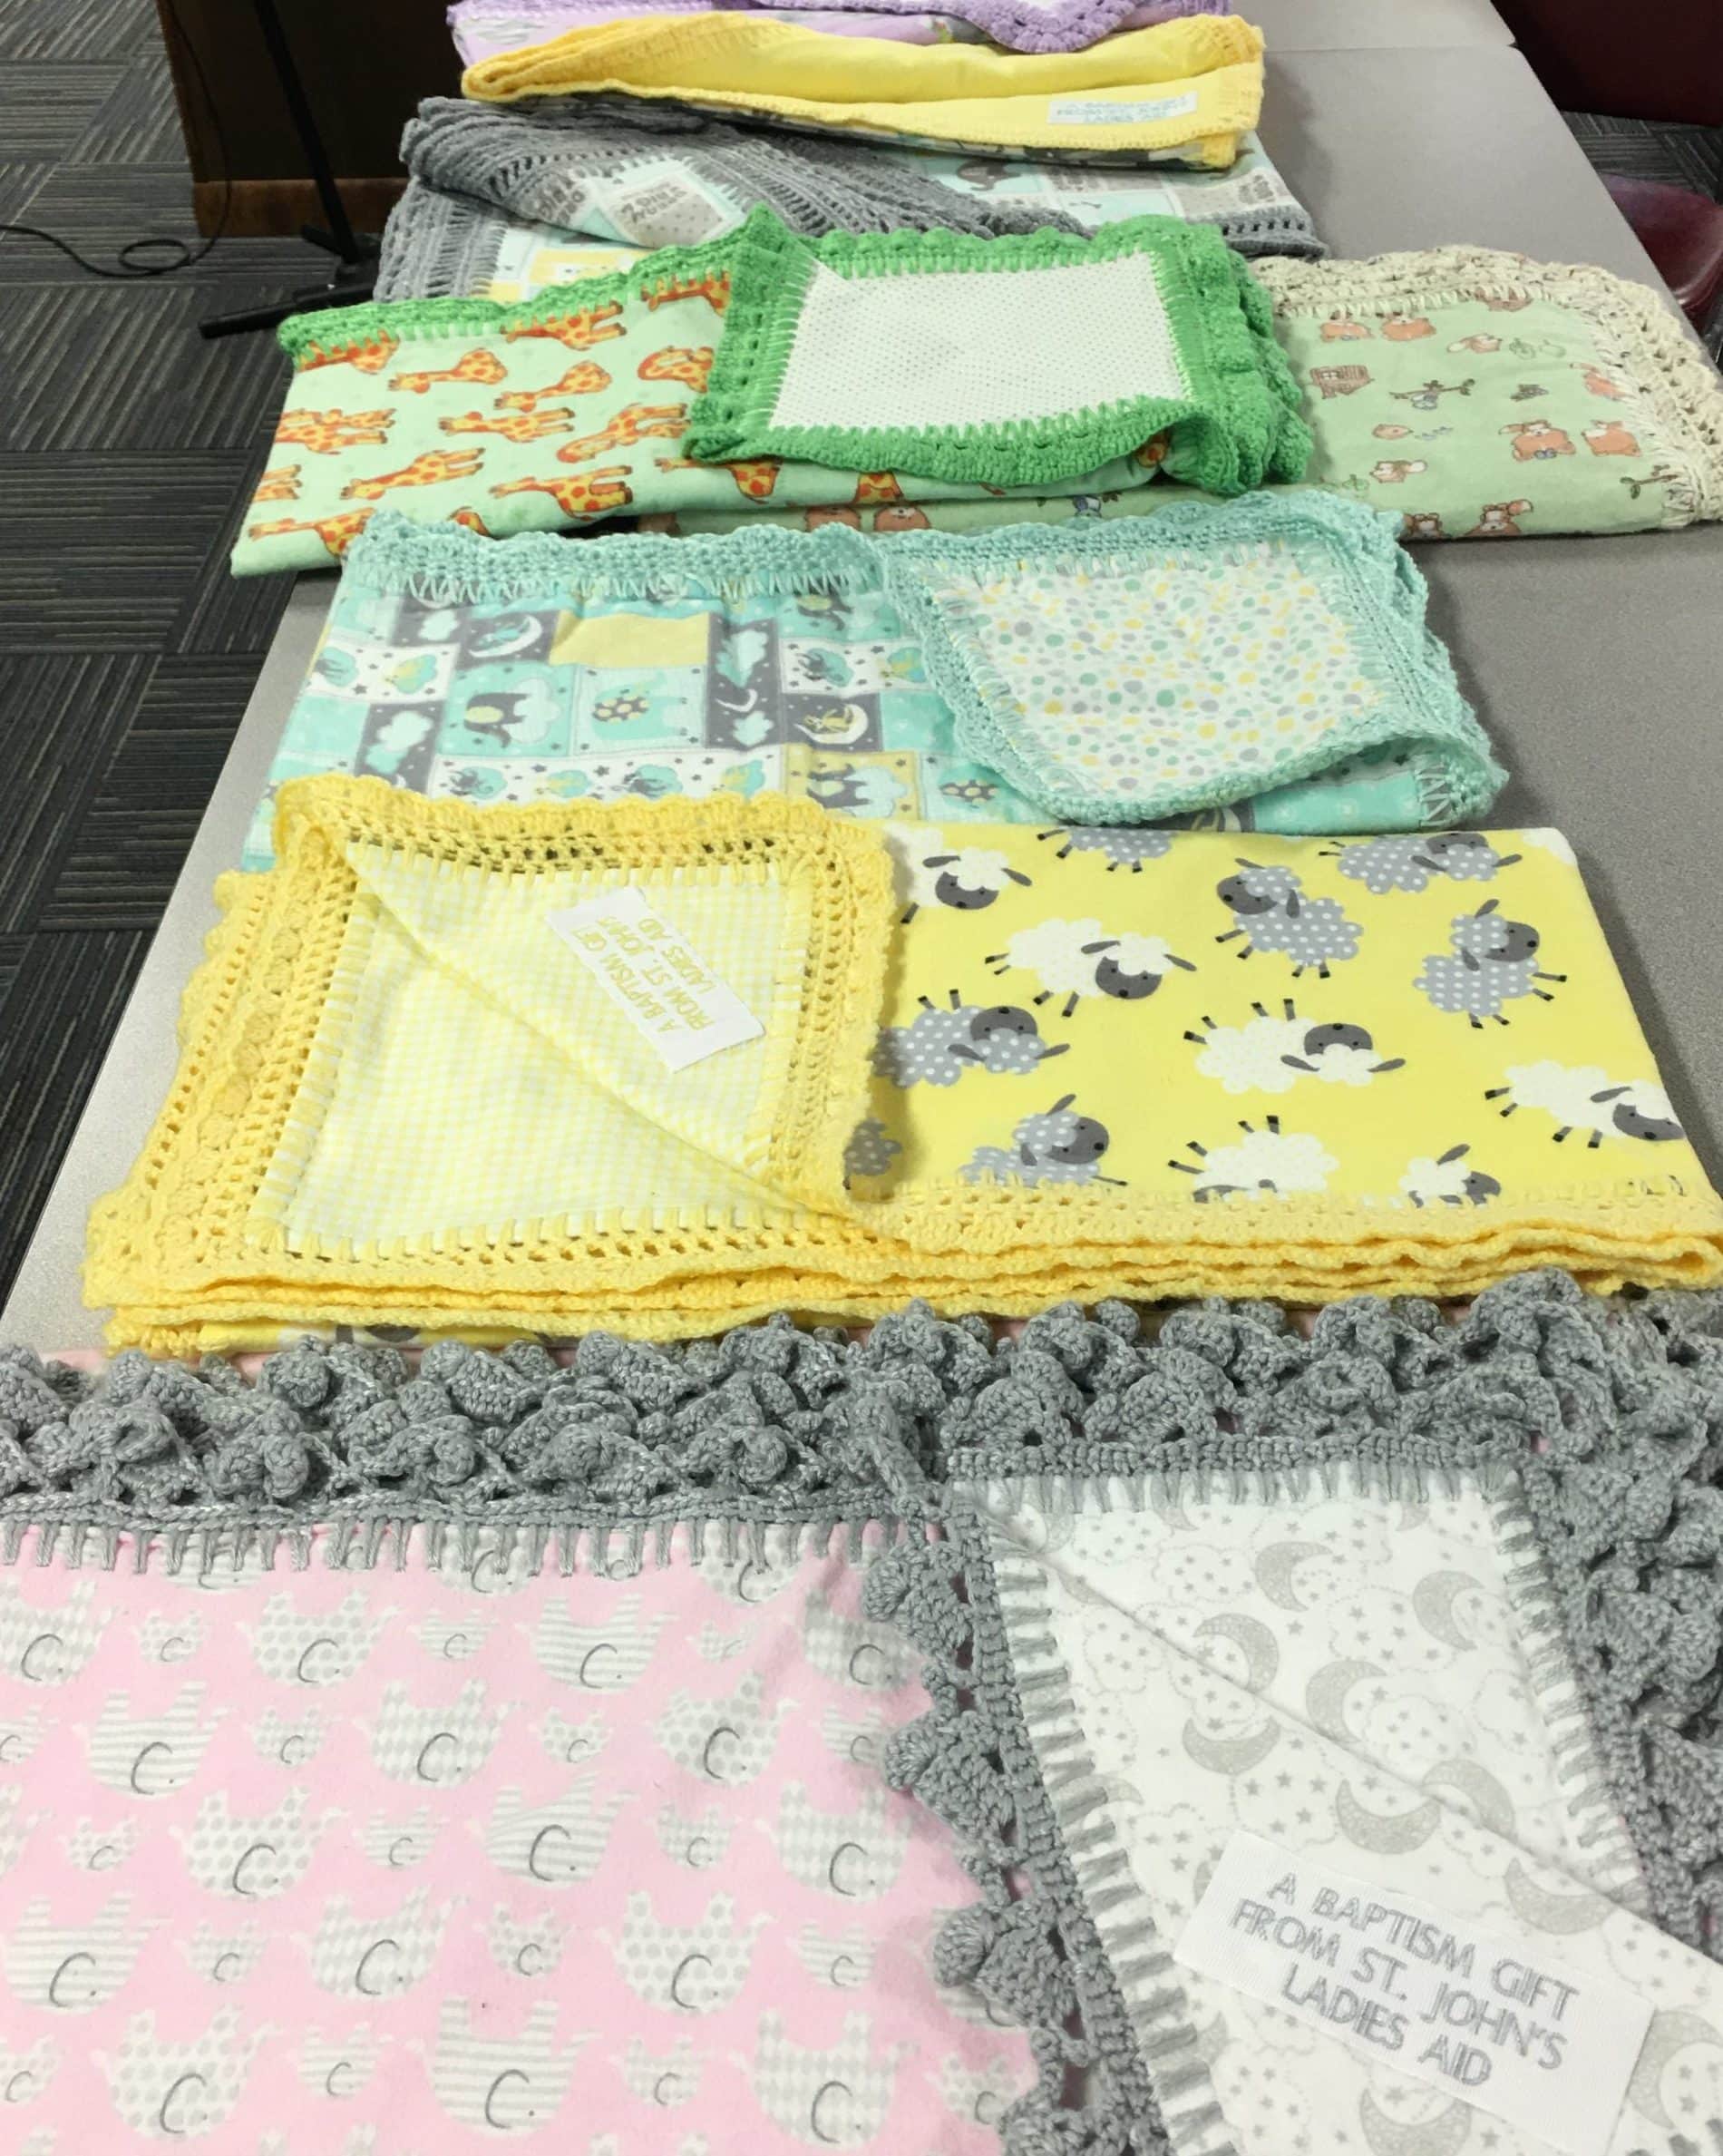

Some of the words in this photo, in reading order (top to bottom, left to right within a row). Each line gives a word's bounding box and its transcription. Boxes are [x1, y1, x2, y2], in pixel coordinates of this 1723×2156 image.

[638, 918, 673, 941] AID
[599, 953, 666, 1019] BAPTISM
[663, 988, 715, 1030] FROM
[657, 1019, 683, 1032] A
[1266, 1872, 1295, 1905] A
[1312, 1887, 1475, 1978] BAPTISM
[1492, 1959, 1580, 2021] GIFT
[1230, 1898, 1340, 1967] FROM
[1351, 1946, 1408, 2001] ST.
[1419, 1981, 1567, 2070] JOHN'S
[1281, 1962, 1410, 2052] LADIES
[1416, 2034, 1492, 2085] AID
